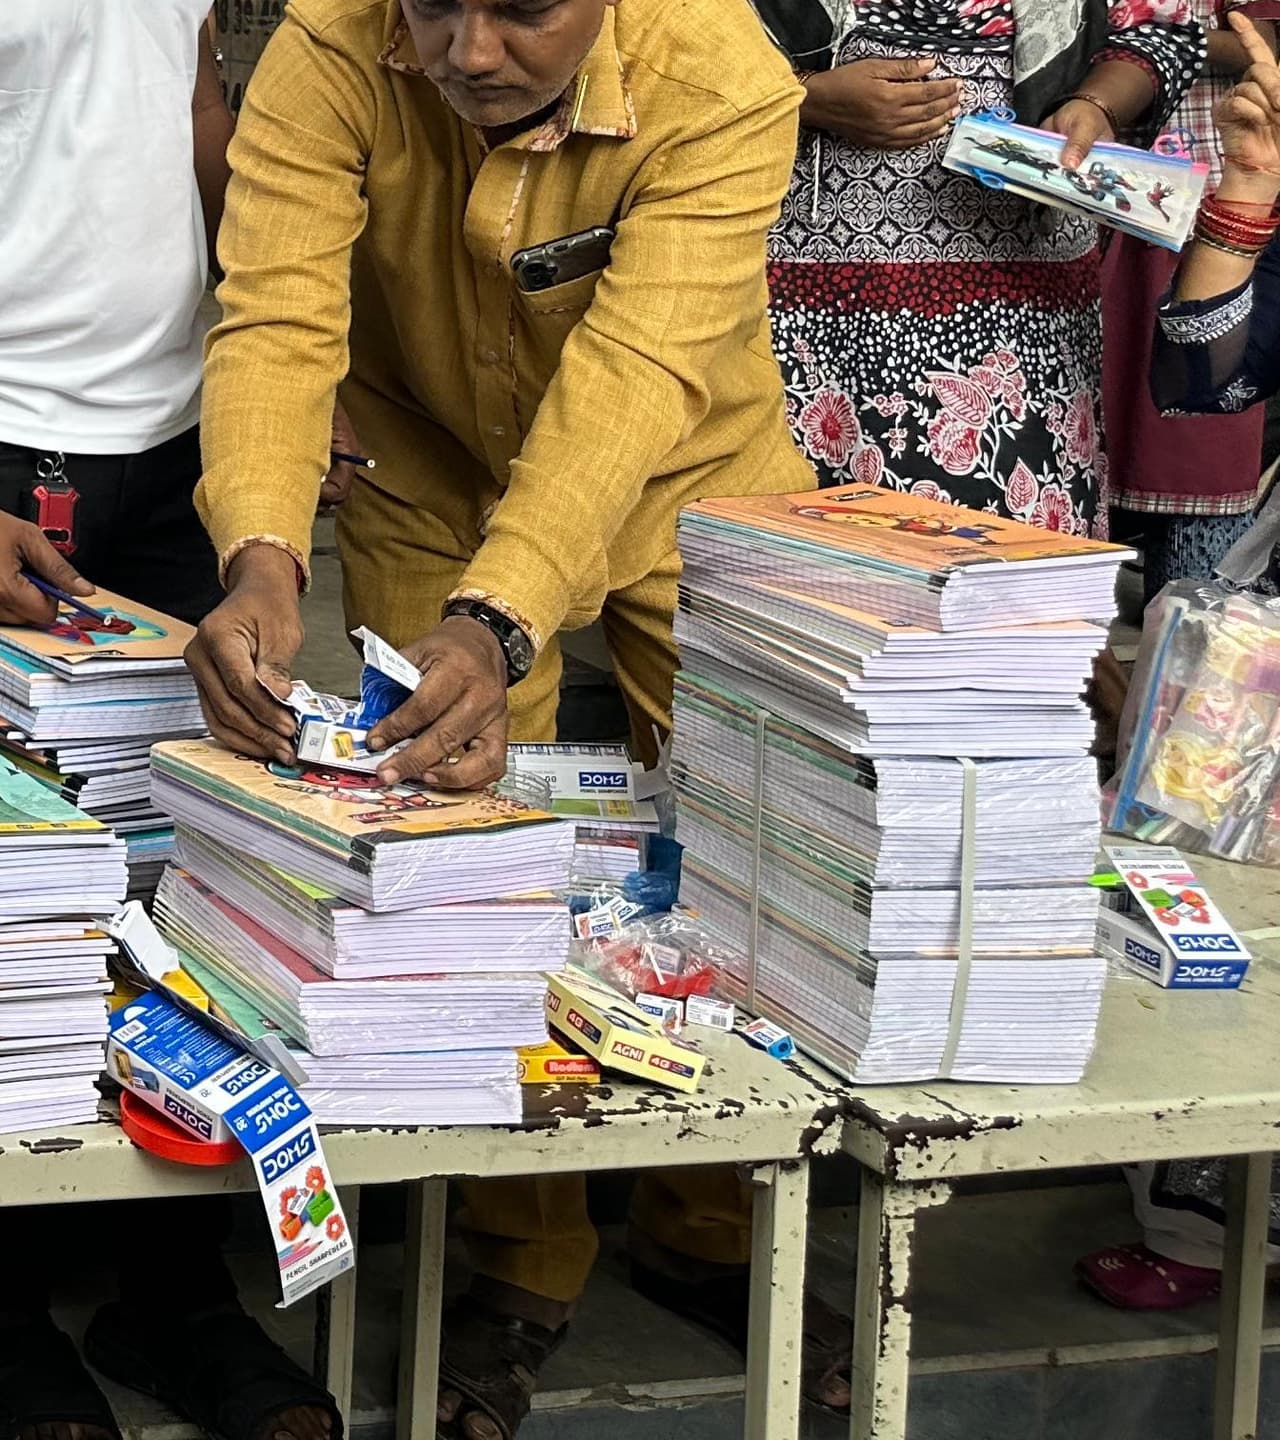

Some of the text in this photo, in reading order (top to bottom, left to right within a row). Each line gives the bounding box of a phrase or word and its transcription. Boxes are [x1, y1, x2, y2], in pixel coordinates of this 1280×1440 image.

[581, 774, 625, 786] DOMS
[1126, 940, 1160, 966] DOMS
[1178, 936, 1236, 951] DOMS
[1176, 966, 1232, 977] DOMS
[612, 1043, 670, 1069] AGNI 4G
[227, 1061, 268, 1095] DOMS
[166, 1101, 211, 1138] DOMS
[255, 1093, 302, 1135] DOMS
[263, 1133, 311, 1179] DOMS
[286, 1262, 309, 1281] PENCIL
